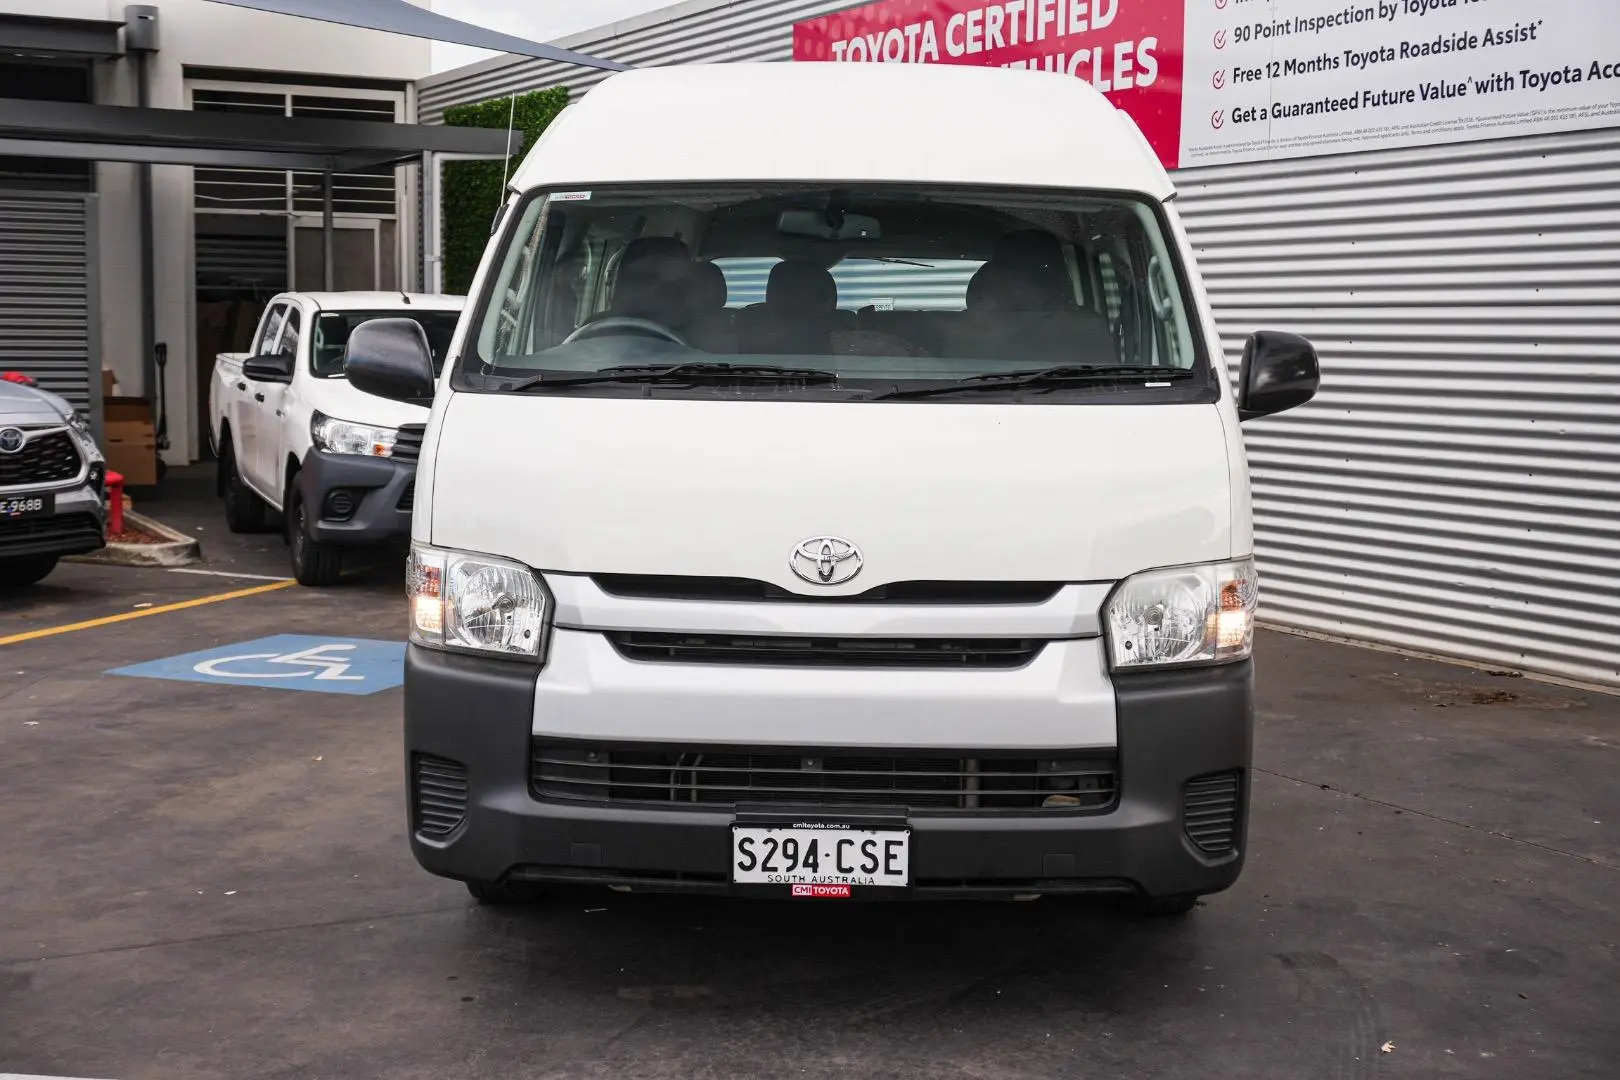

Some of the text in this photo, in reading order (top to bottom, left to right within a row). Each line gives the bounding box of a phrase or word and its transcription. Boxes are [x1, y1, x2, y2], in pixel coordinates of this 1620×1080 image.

[831, 0, 1119, 63] TOYOTA CERTIFIED
[1234, 26, 1251, 43] 90
[1254, 20, 1291, 40] Point
[1294, 6, 1374, 34] Inspection
[1378, 0, 1398, 21] by
[1233, 67, 1262, 84] Free
[1265, 61, 1280, 79] 12
[1284, 53, 1340, 77] Months
[1343, 45, 1395, 69] Toyota
[1400, 31, 1478, 59] Roadside
[1231, 107, 1257, 124] Get
[1260, 108, 1268, 120] a
[1271, 91, 1359, 119] Guaranteed
[1362, 87, 1415, 108] Future
[1475, 71, 1515, 95] with
[1519, 65, 1582, 92] Toyota
[767, 874, 875, 885] SOUTH AUSTRALIA
[794, 885, 849, 895] CMI TOYOTA
